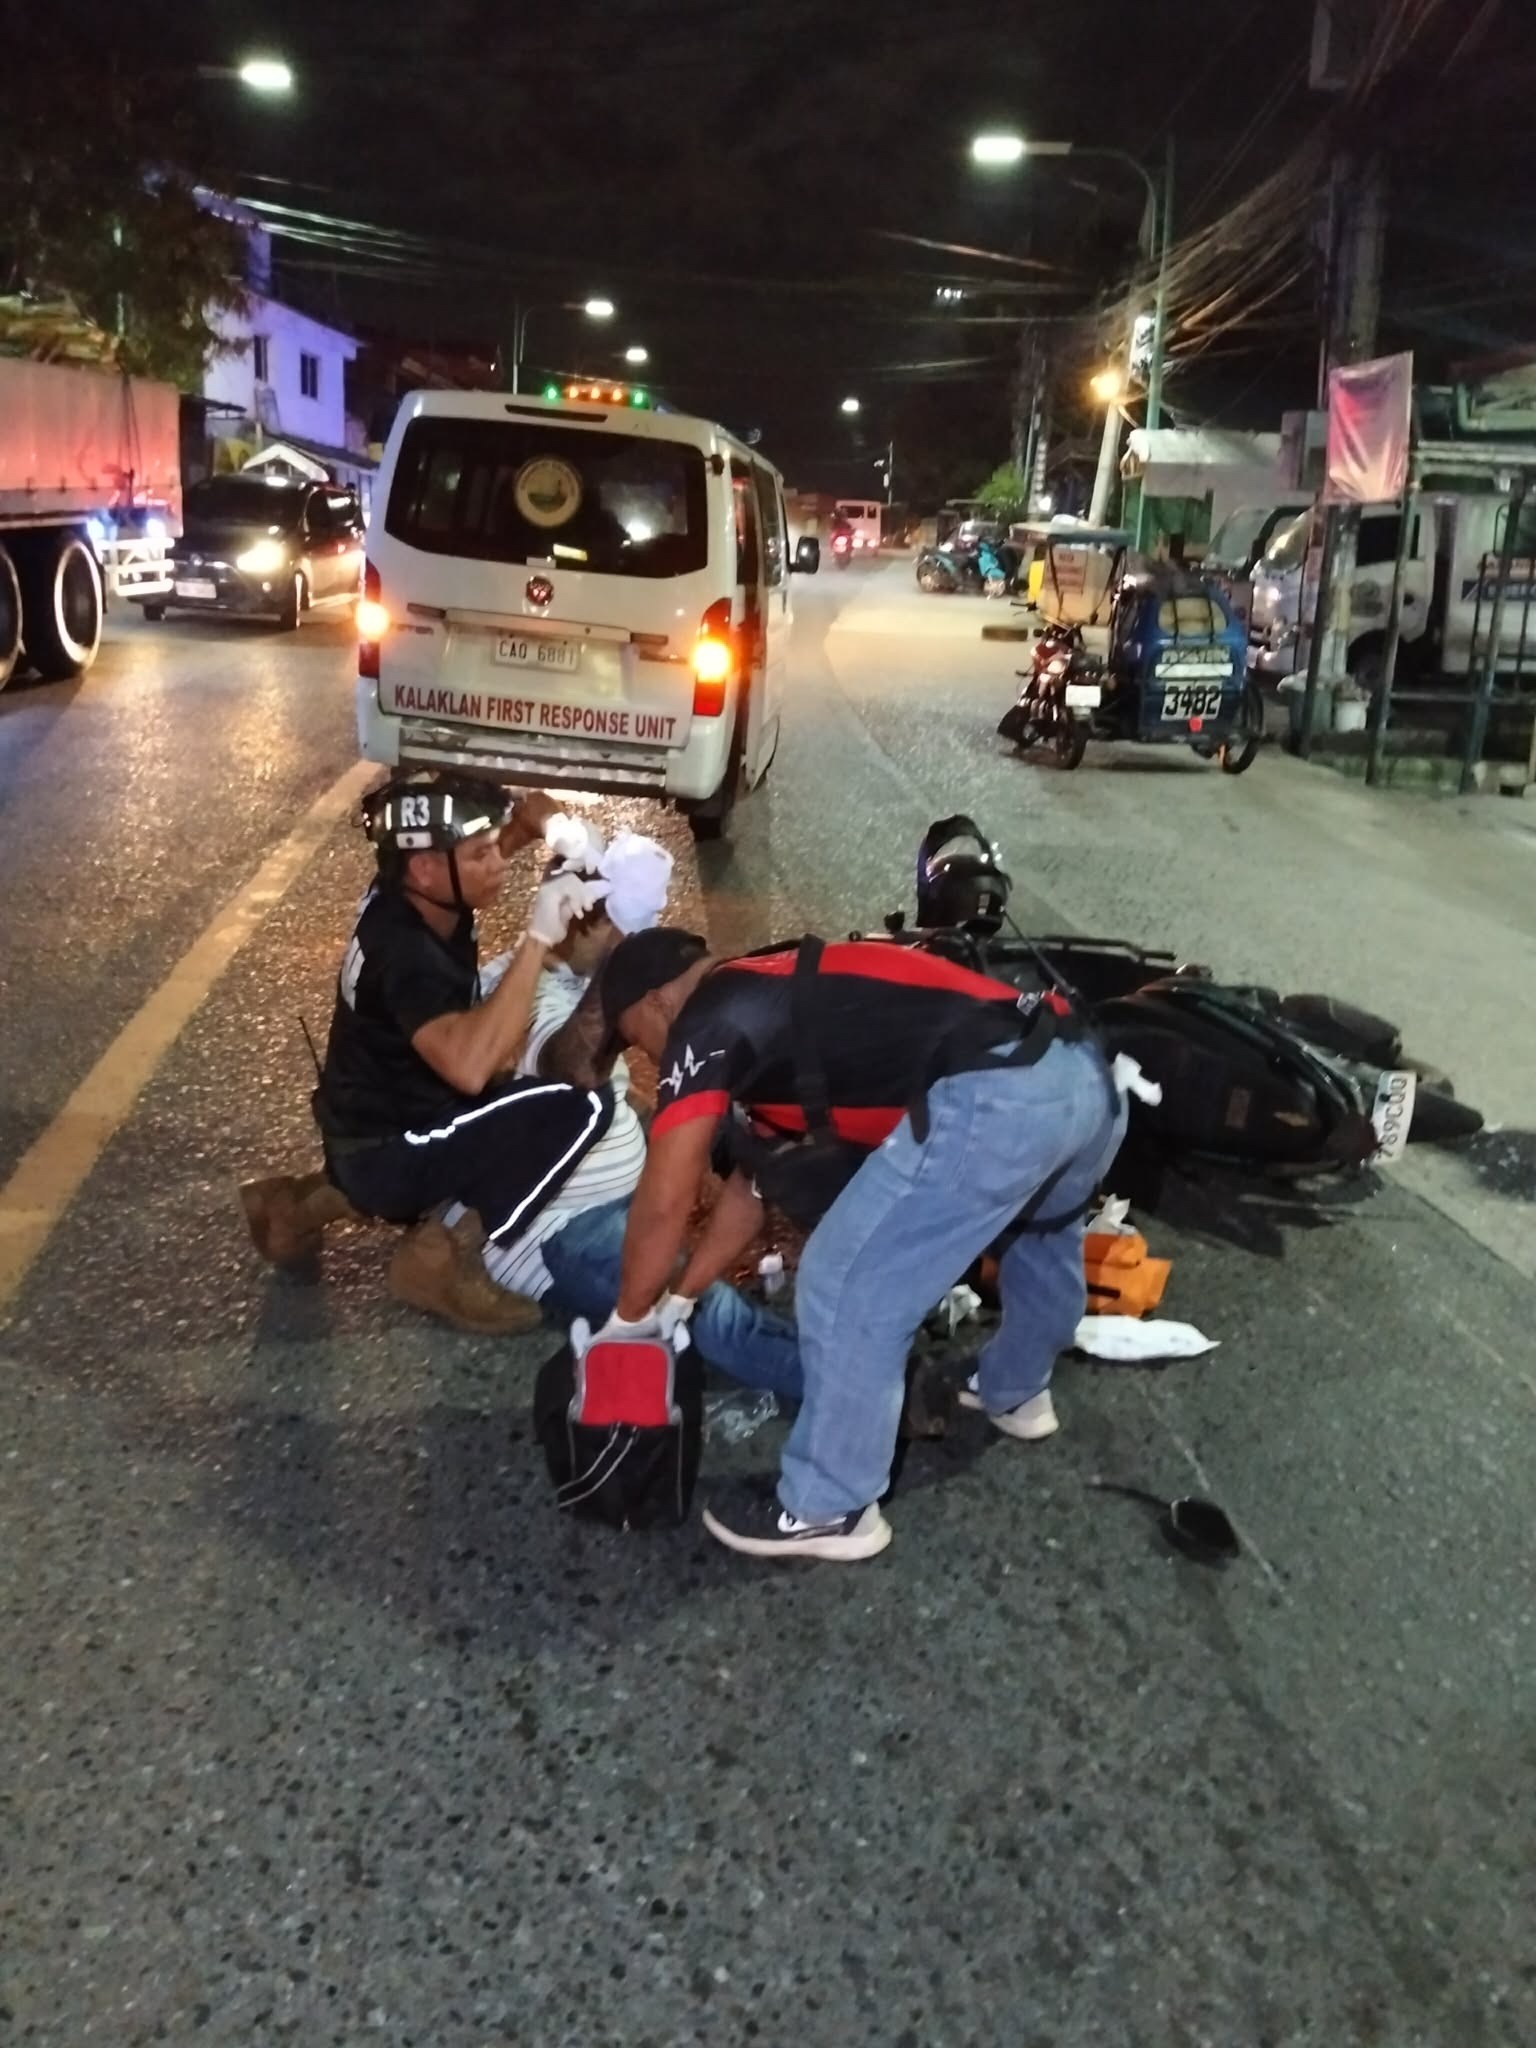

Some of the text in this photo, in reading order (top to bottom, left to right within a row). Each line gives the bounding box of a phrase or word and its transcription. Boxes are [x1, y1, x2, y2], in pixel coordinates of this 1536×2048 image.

[394, 684, 677, 740] KALAKLAN FIRST RESPONSE UNIT
[401, 795, 430, 827] R3
